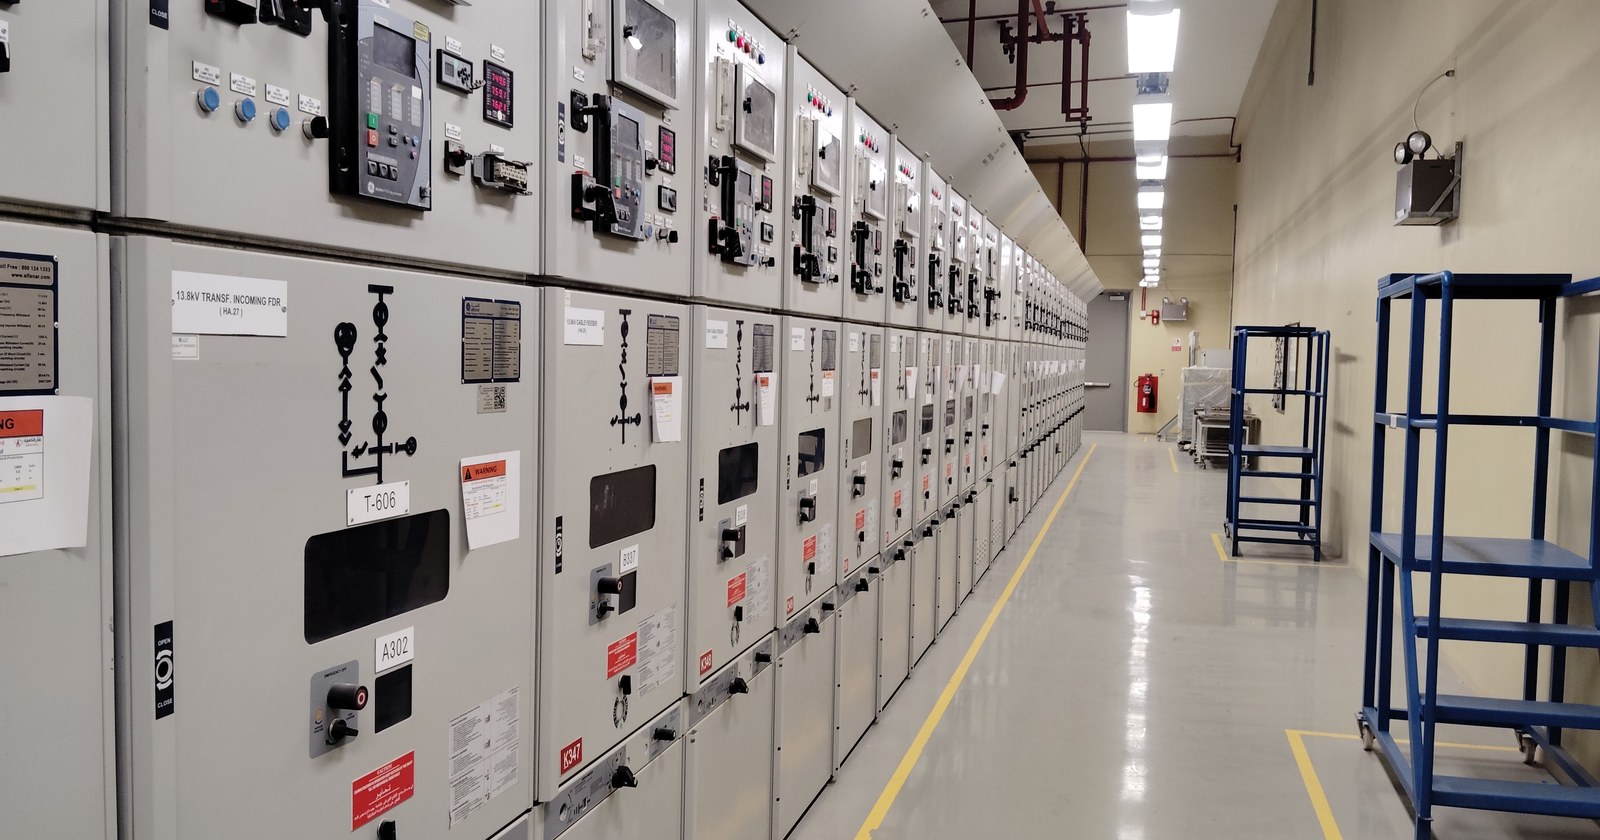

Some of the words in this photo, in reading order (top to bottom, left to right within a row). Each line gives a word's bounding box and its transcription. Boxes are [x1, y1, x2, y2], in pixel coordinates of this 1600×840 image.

[151, 8, 168, 20] CLOSE
[176, 290, 200, 302] 13.8kV
[201, 292, 232, 304] TRANSF.
[233, 295, 267, 306] INCOMING
[267, 297, 281, 307] FDR
[222, 307, 240, 316] HA.27
[474, 465, 498, 476] WARNING
[364, 491, 396, 513] T-606
[157, 637, 171, 647] OPEN
[381, 636, 408, 662] A302
[157, 697, 173, 709] CLOSE
[563, 742, 581, 770] K347
